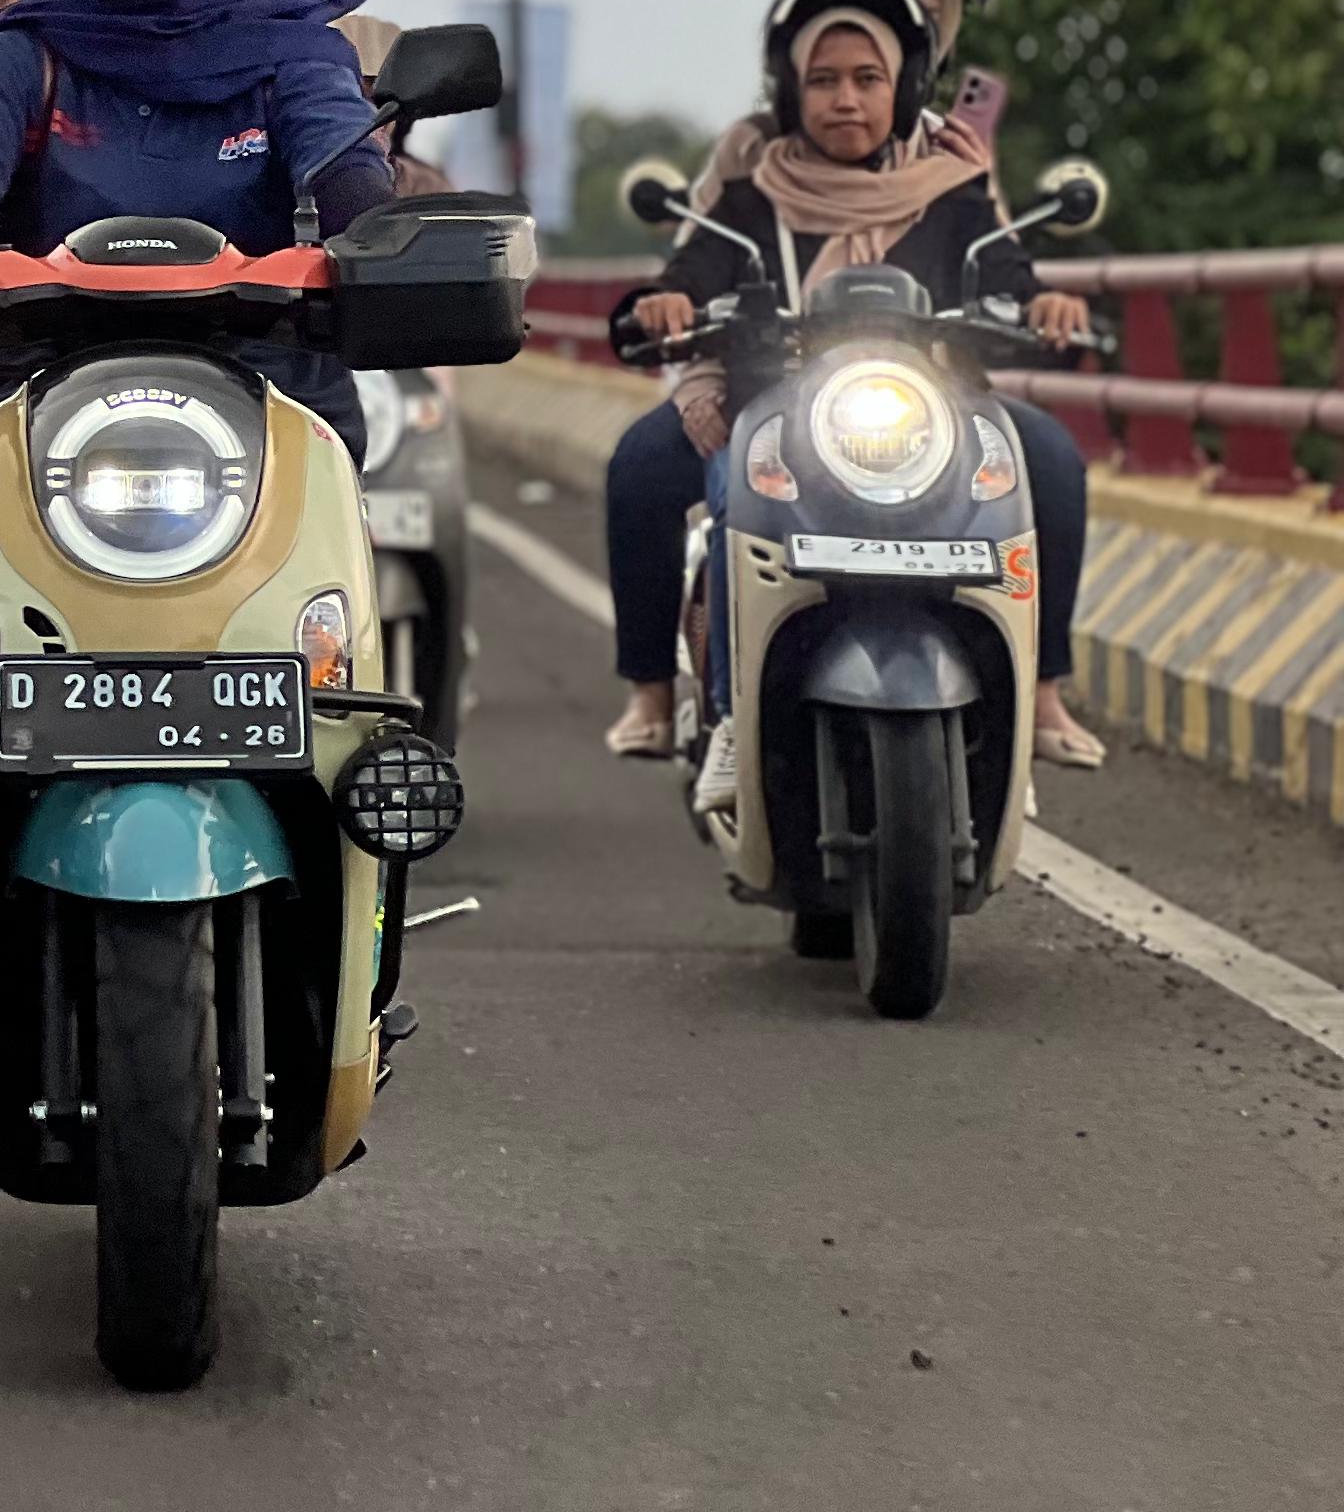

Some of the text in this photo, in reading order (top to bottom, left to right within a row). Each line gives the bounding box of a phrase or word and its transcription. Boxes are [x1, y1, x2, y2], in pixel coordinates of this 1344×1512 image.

[108, 239, 179, 251] HONDA
[106, 388, 188, 407] SCOOPY
[797, 537, 988, 557] E 2319 DS
[11, 671, 288, 710] D 2884 QGK
[158, 725, 203, 747] 04
[244, 725, 286, 746] 26
